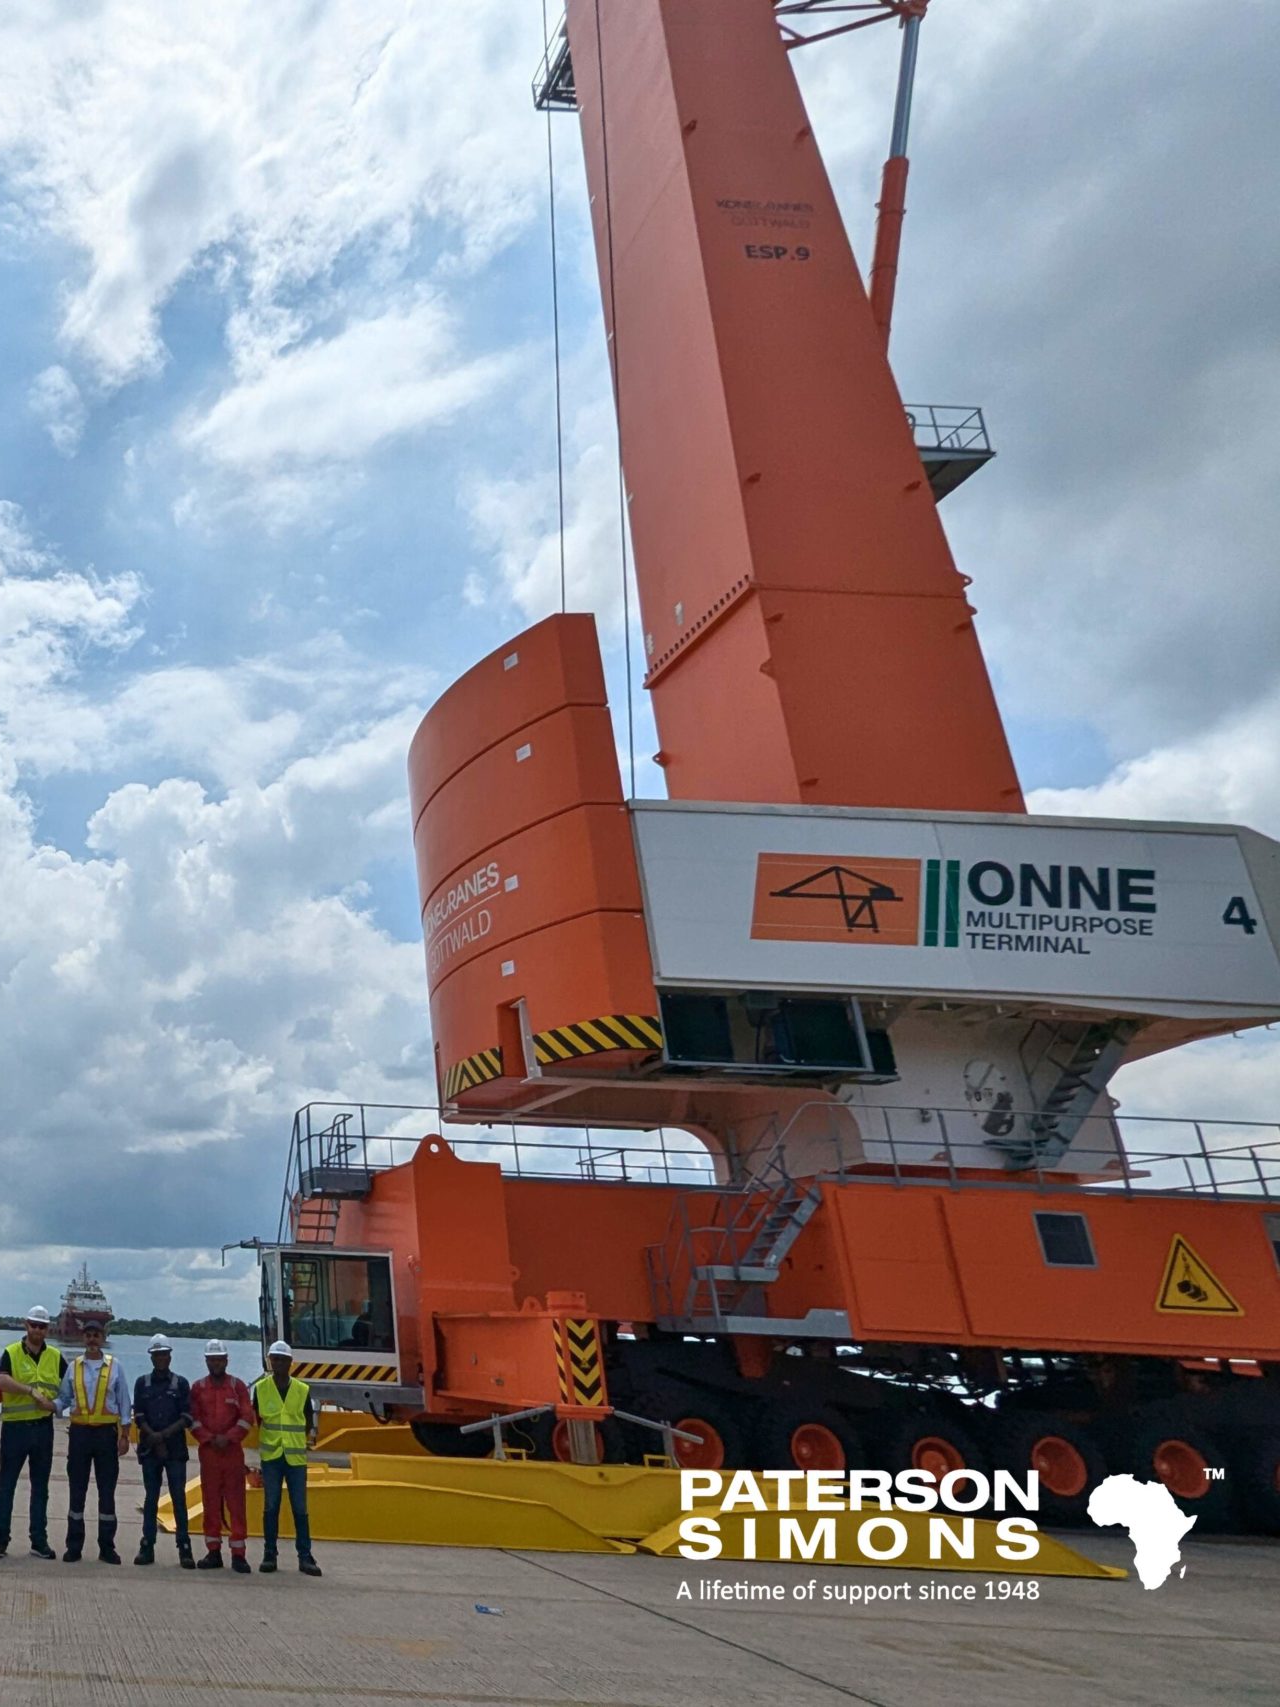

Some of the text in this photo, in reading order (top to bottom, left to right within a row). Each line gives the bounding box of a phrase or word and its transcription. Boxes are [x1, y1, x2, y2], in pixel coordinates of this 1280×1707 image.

[745, 245, 810, 260] ESP.9
[967, 861, 1157, 913] ONNE
[966, 911, 1154, 936] MULTIPURPOSE
[1222, 896, 1257, 935] 4
[966, 932, 1091, 954] TERMINAL
